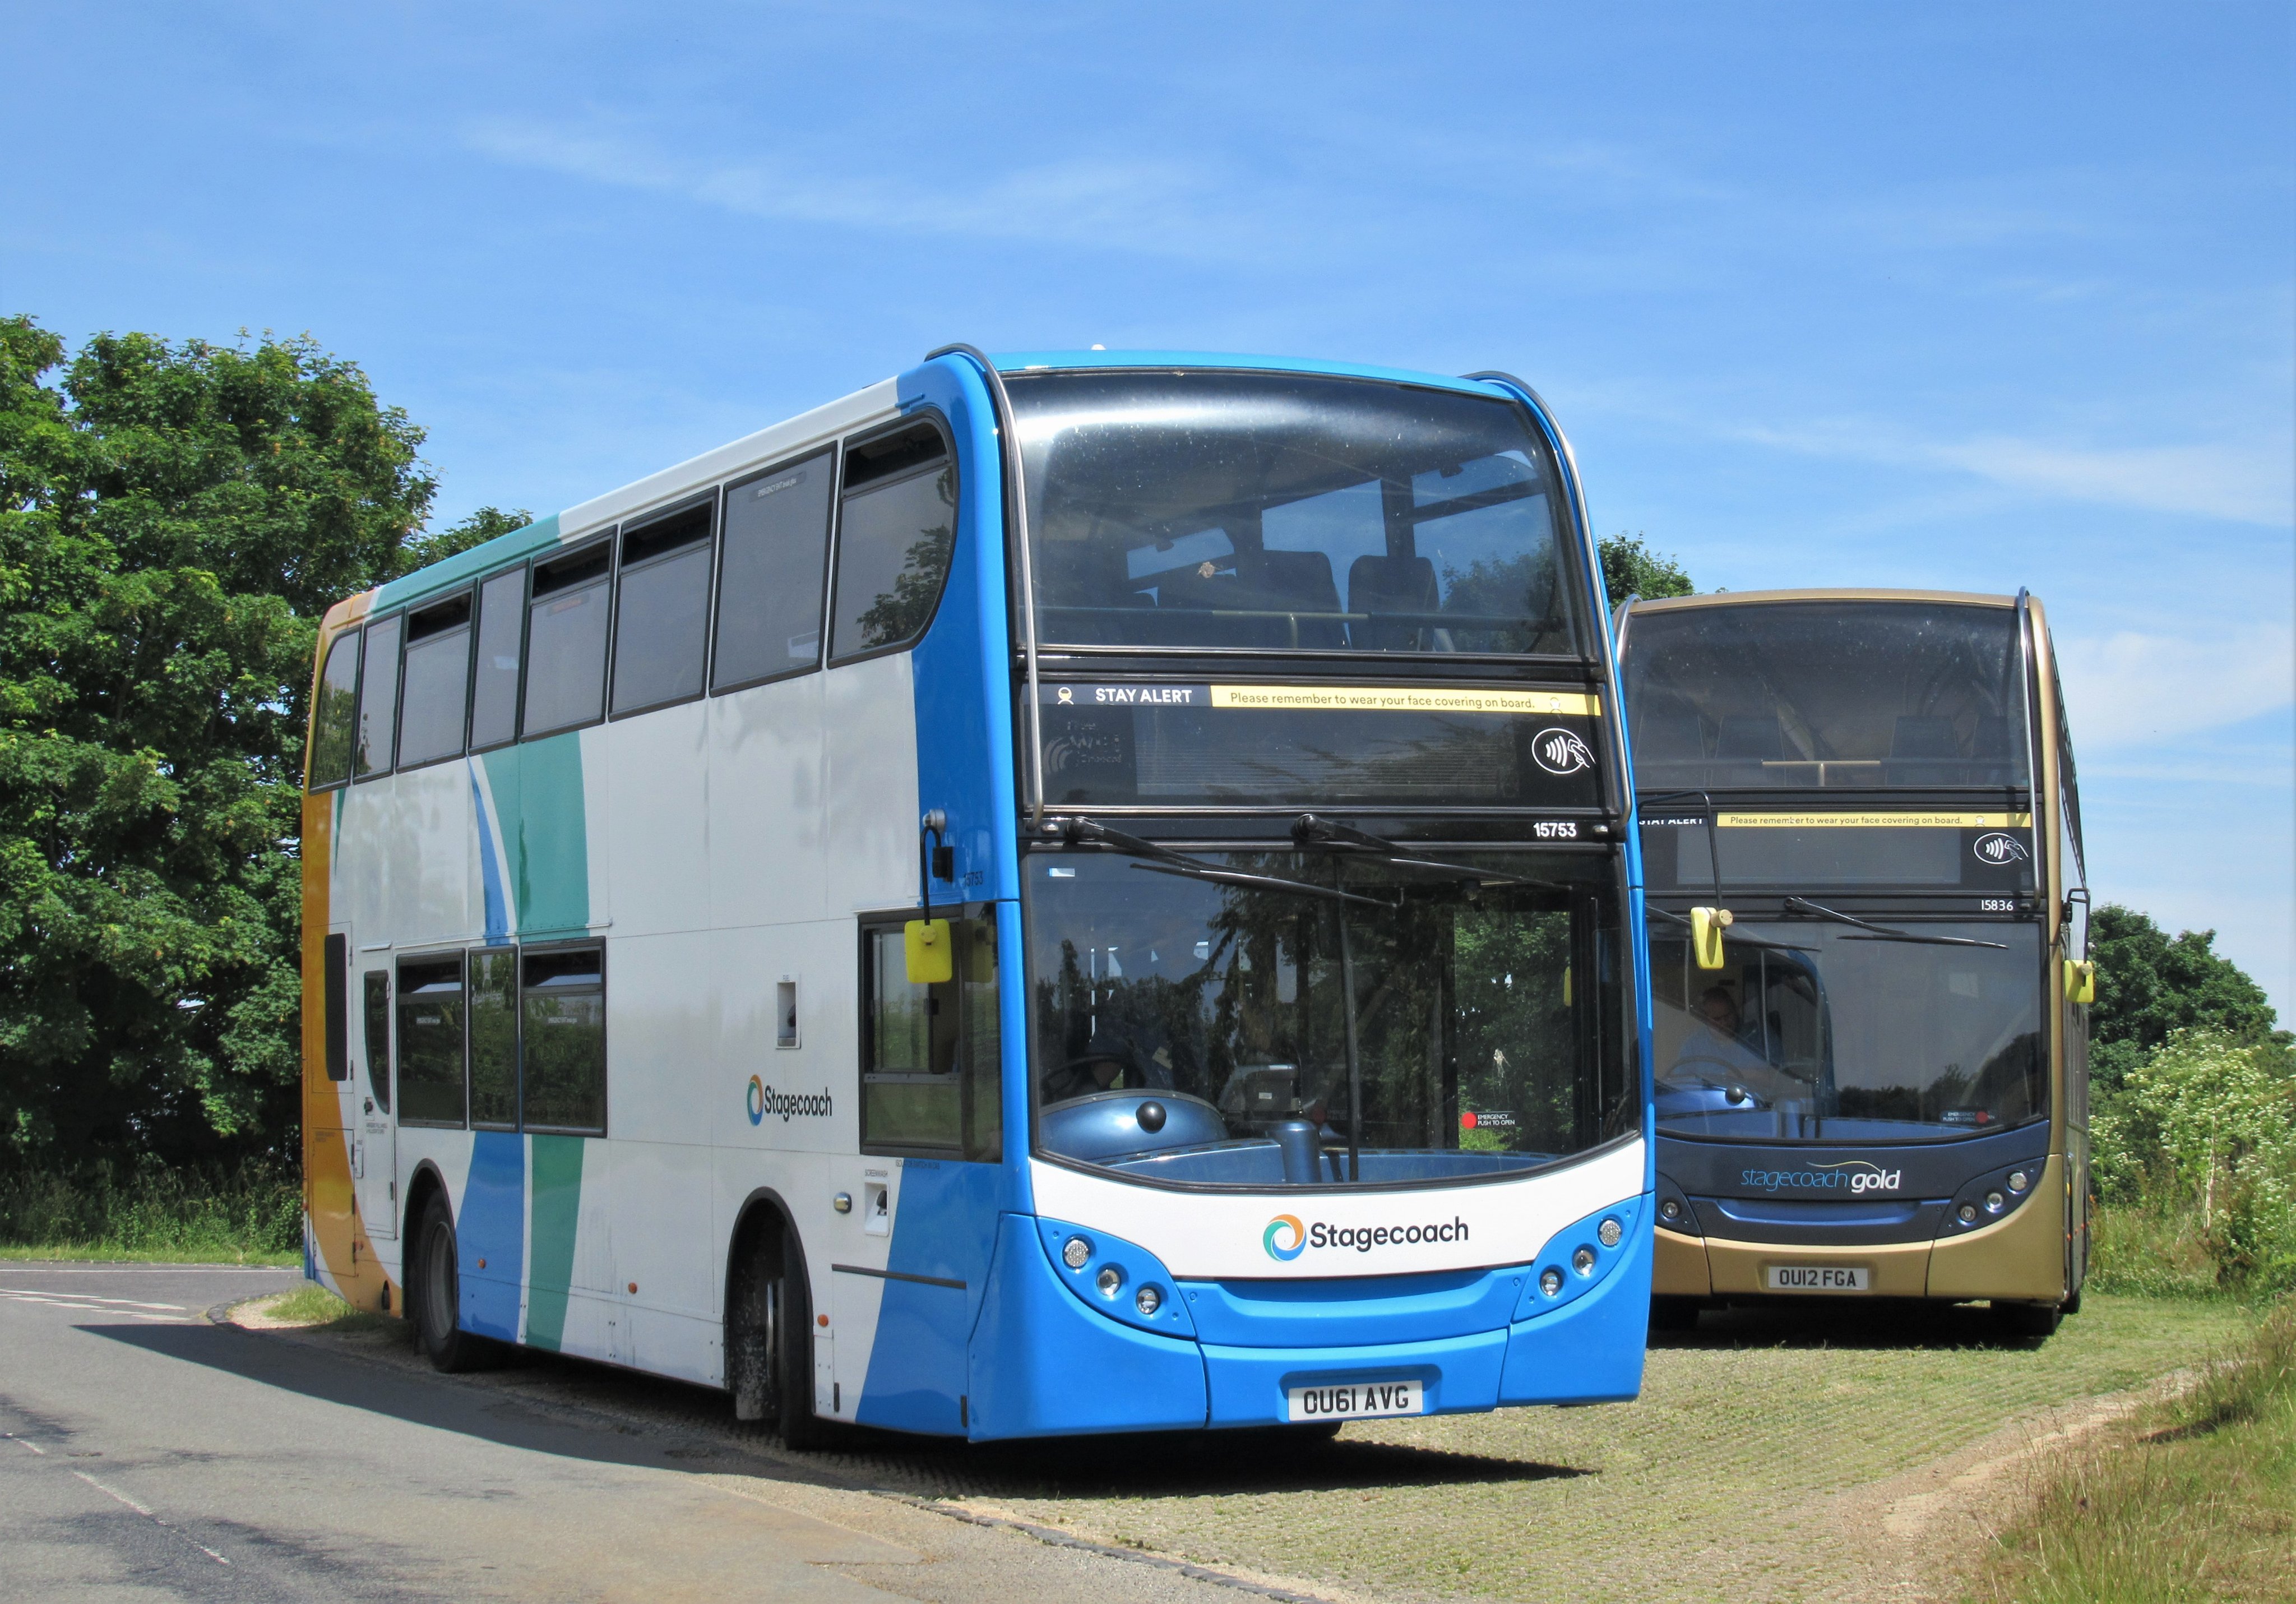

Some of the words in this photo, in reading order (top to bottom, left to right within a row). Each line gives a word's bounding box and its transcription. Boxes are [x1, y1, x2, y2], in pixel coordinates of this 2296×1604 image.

[1095, 688, 1136, 702] STAY
[1140, 689, 1192, 703] ALERT
[1230, 692, 1269, 704] Please
[1272, 694, 1332, 704] remember
[1335, 695, 1346, 704] to
[1349, 696, 1377, 705] wear
[1380, 697, 1405, 707] your
[1408, 695, 1432, 705] face
[1435, 697, 1482, 709] covering
[1501, 697, 1535, 709] board.
[1882, 816, 1919, 825] covering
[1533, 822, 1577, 837] 15753
[1981, 900, 2013, 911] 15836
[765, 1085, 832, 1122] Stagecoach
[1742, 1168, 1847, 1191] stagecoach
[1851, 1170, 1901, 1192] gold
[1310, 1215, 1469, 1252] Stagecoach
[1779, 1269, 1818, 1286] OU12
[1822, 1270, 1856, 1287] FGA
[1304, 1388, 1357, 1414] OU61
[1364, 1385, 1408, 1410] AVG
